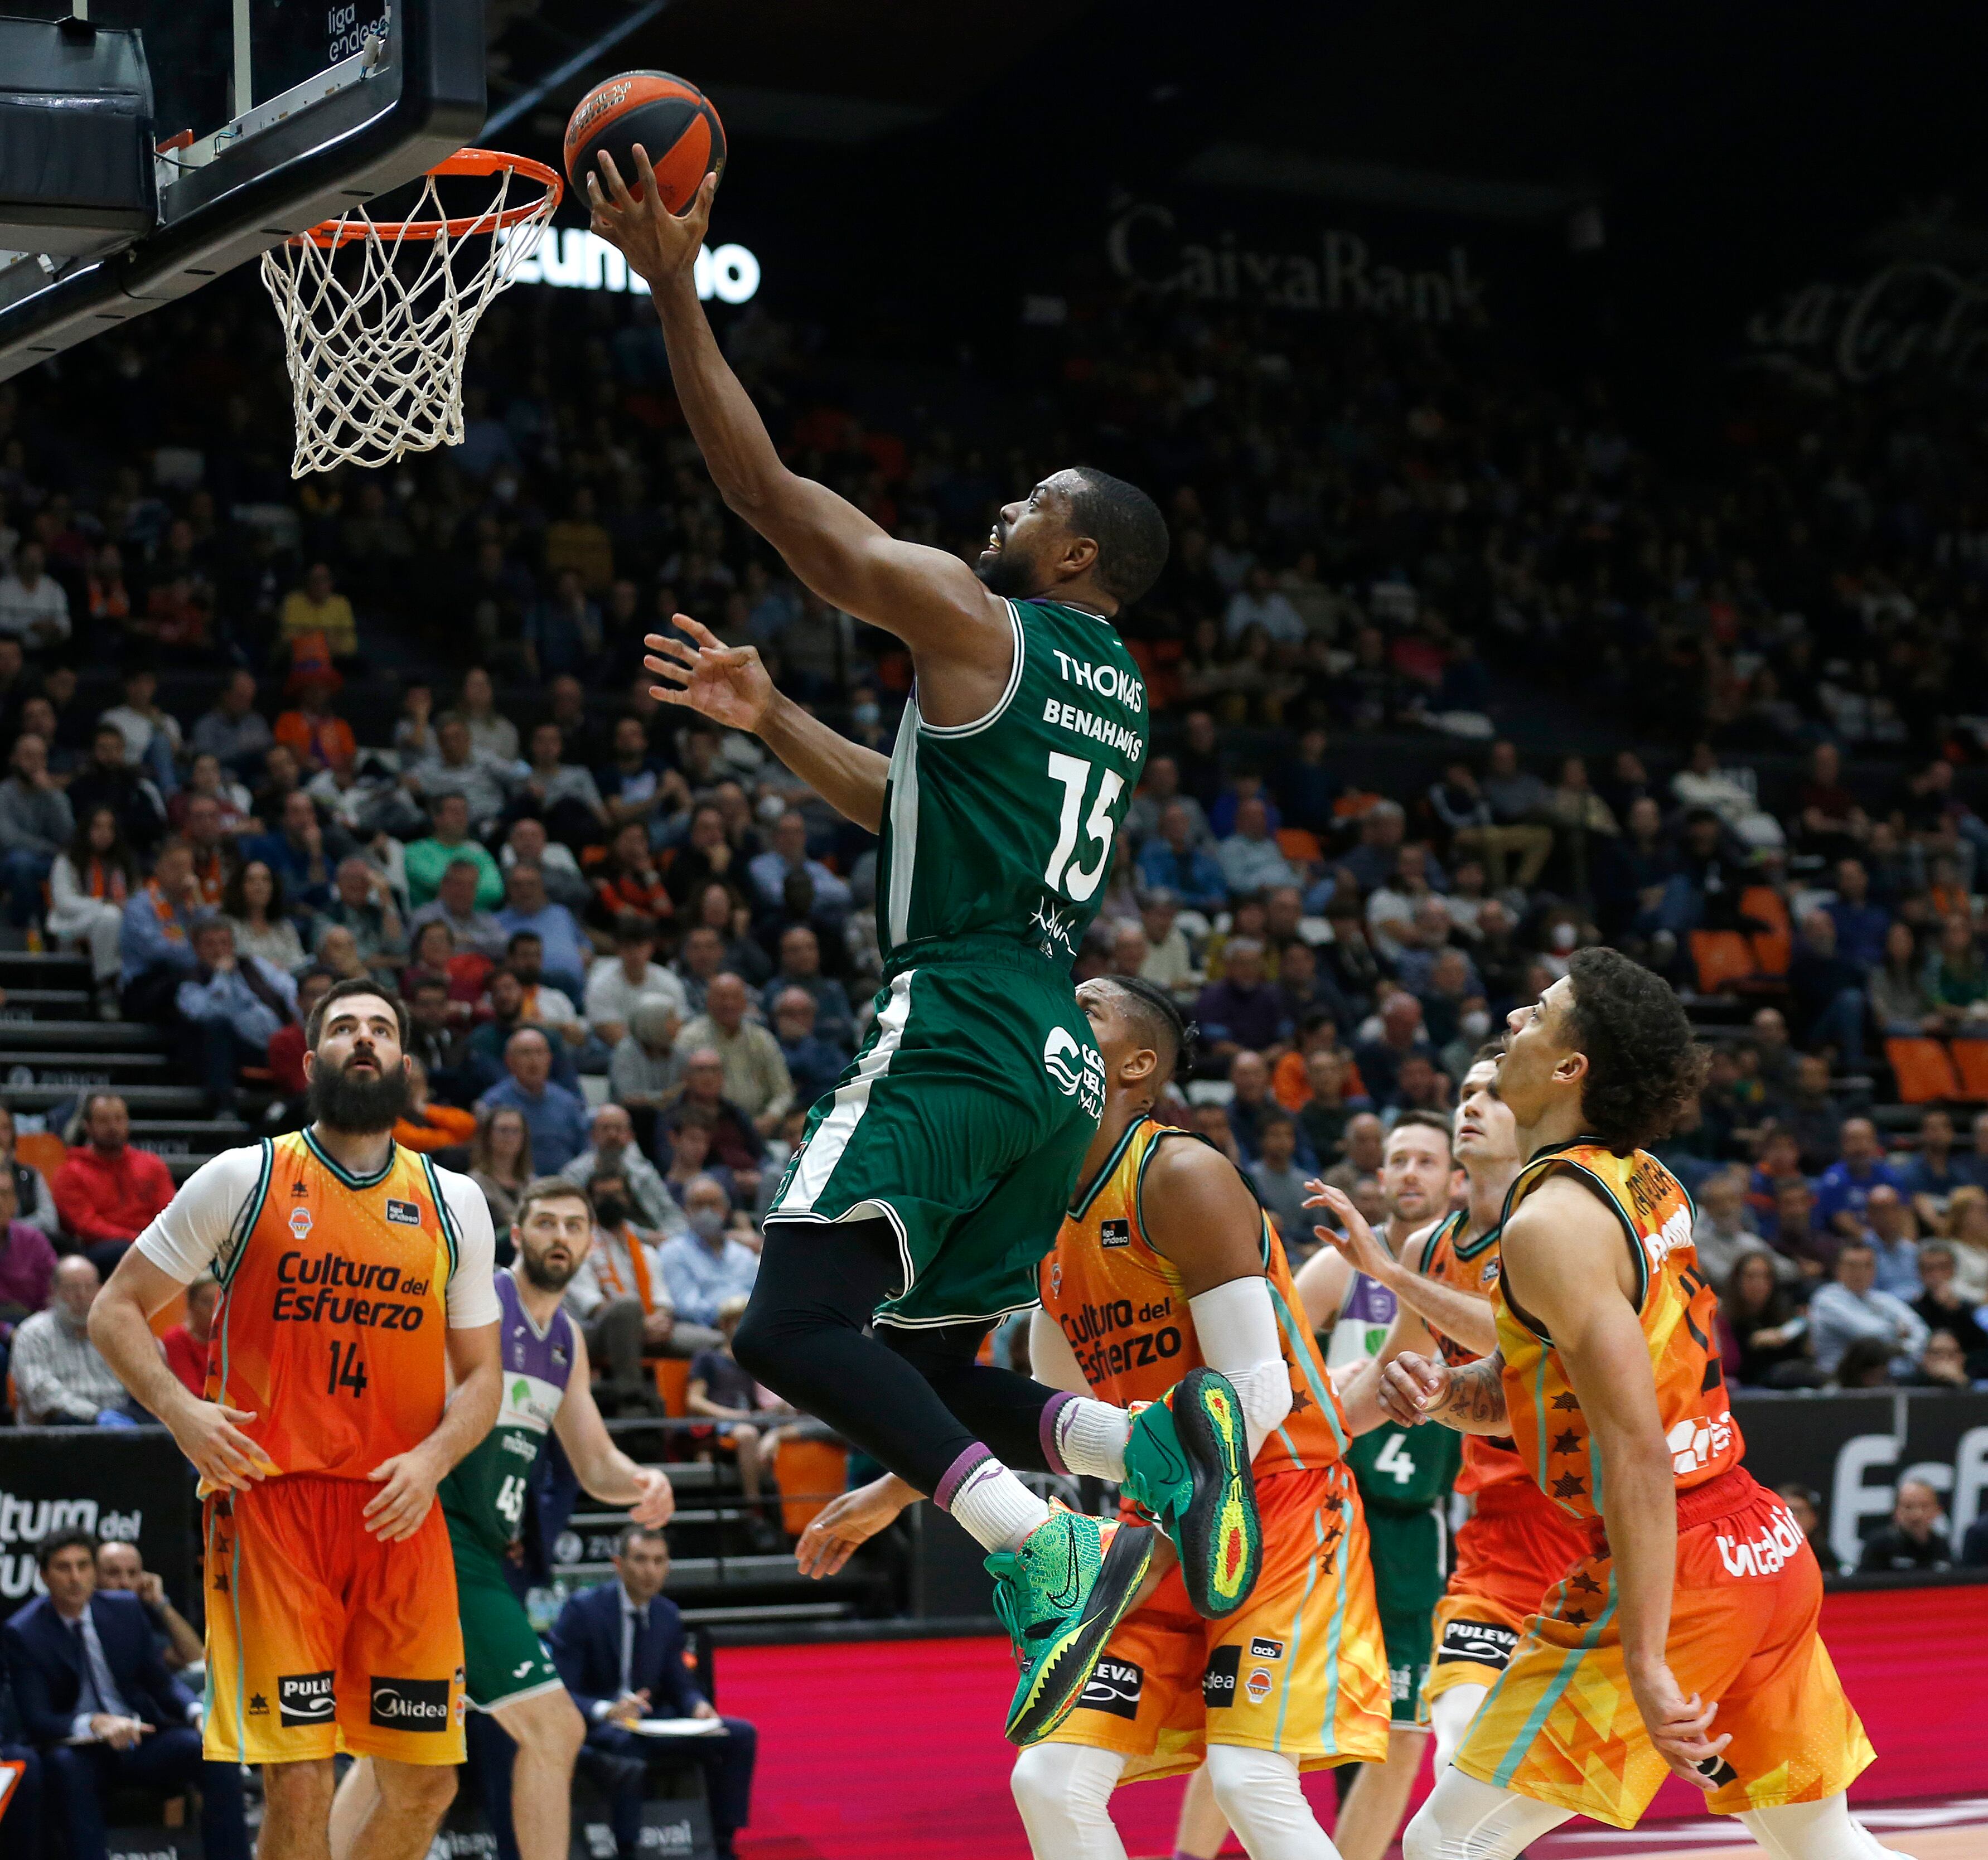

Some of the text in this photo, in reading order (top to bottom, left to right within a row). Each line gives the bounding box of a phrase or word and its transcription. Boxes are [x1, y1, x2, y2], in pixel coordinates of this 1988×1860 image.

[328, 3, 355, 35] liga
[496, 223, 761, 304] zumo
[1053, 648, 1143, 713] THOMAS
[1044, 750, 1125, 902] 15
[1102, 1229, 1114, 1238] liga
[1102, 1236, 1128, 1245] endesa
[277, 1251, 429, 1296] Cultura del
[273, 1287, 424, 1331] Esfuerzo
[1060, 1296, 1172, 1349] Cultura del
[327, 1340, 367, 1398] 14
[1375, 1433, 1415, 1484] 4
[99, 1509, 142, 1541] del
[1253, 1646, 1276, 1657] acb
[1445, 1622, 1520, 1645] PULEVA
[388, 1698, 447, 1718] Midea
